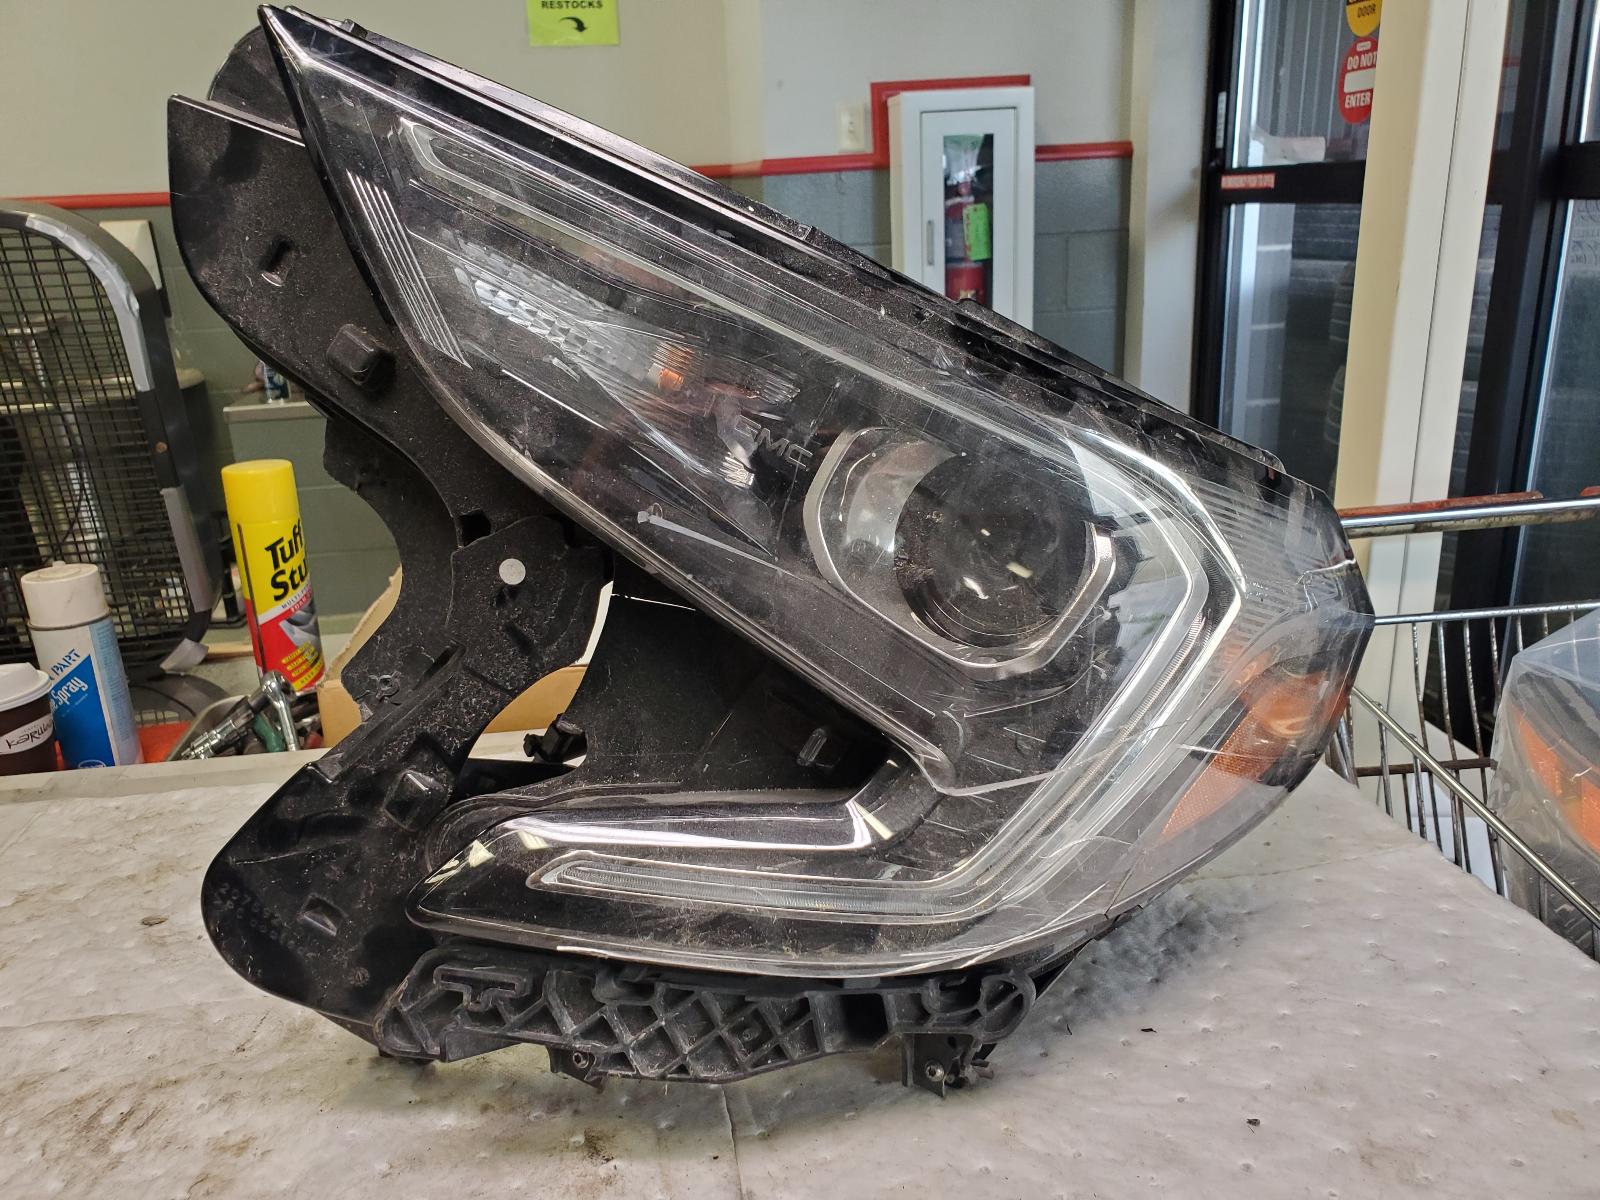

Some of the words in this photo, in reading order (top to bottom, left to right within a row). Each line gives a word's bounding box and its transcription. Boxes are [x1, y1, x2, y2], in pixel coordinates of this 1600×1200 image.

[541, 0, 603, 9] RESTOCKS
[1357, 3, 1376, 18] DOOR
[1346, 55, 1360, 71] DO
[1360, 52, 1377, 68] NOT
[1344, 91, 1371, 109] ENTER
[265, 518, 303, 572] Tuff
[51, 676, 89, 705] Spray
